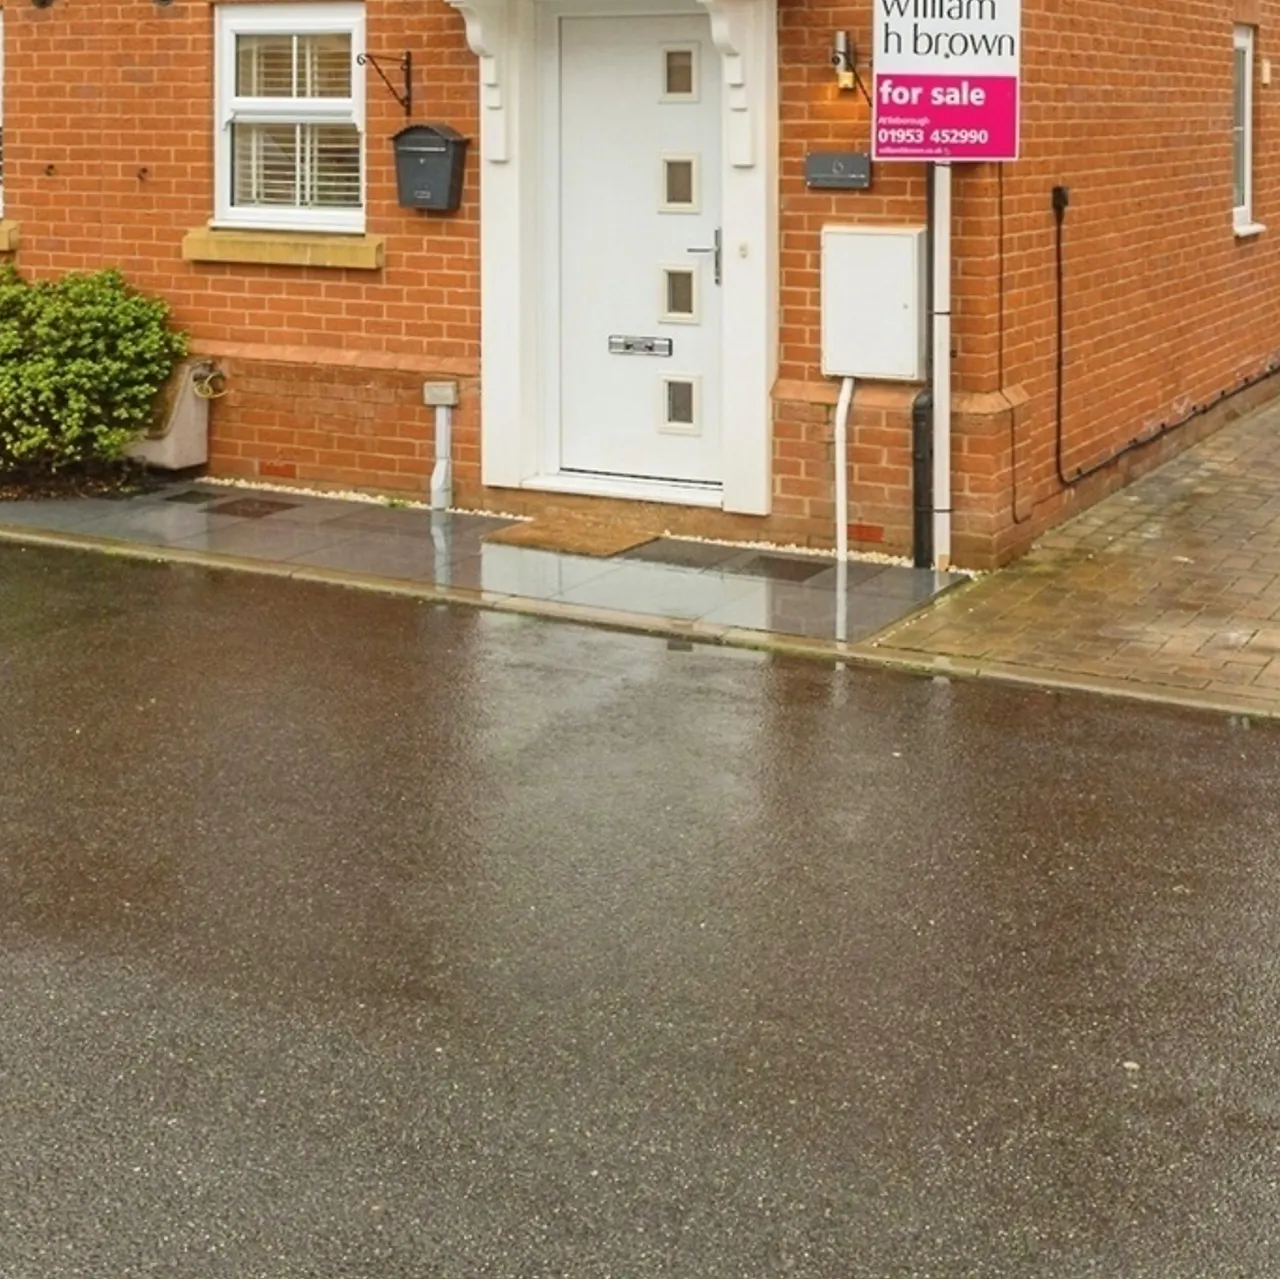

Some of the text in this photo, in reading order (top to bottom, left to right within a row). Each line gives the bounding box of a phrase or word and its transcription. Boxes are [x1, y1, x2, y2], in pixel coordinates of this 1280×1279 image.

[884, 22, 1015, 57] h brown
[879, 79, 986, 106] for sale
[878, 128, 989, 145] 01953 452990
